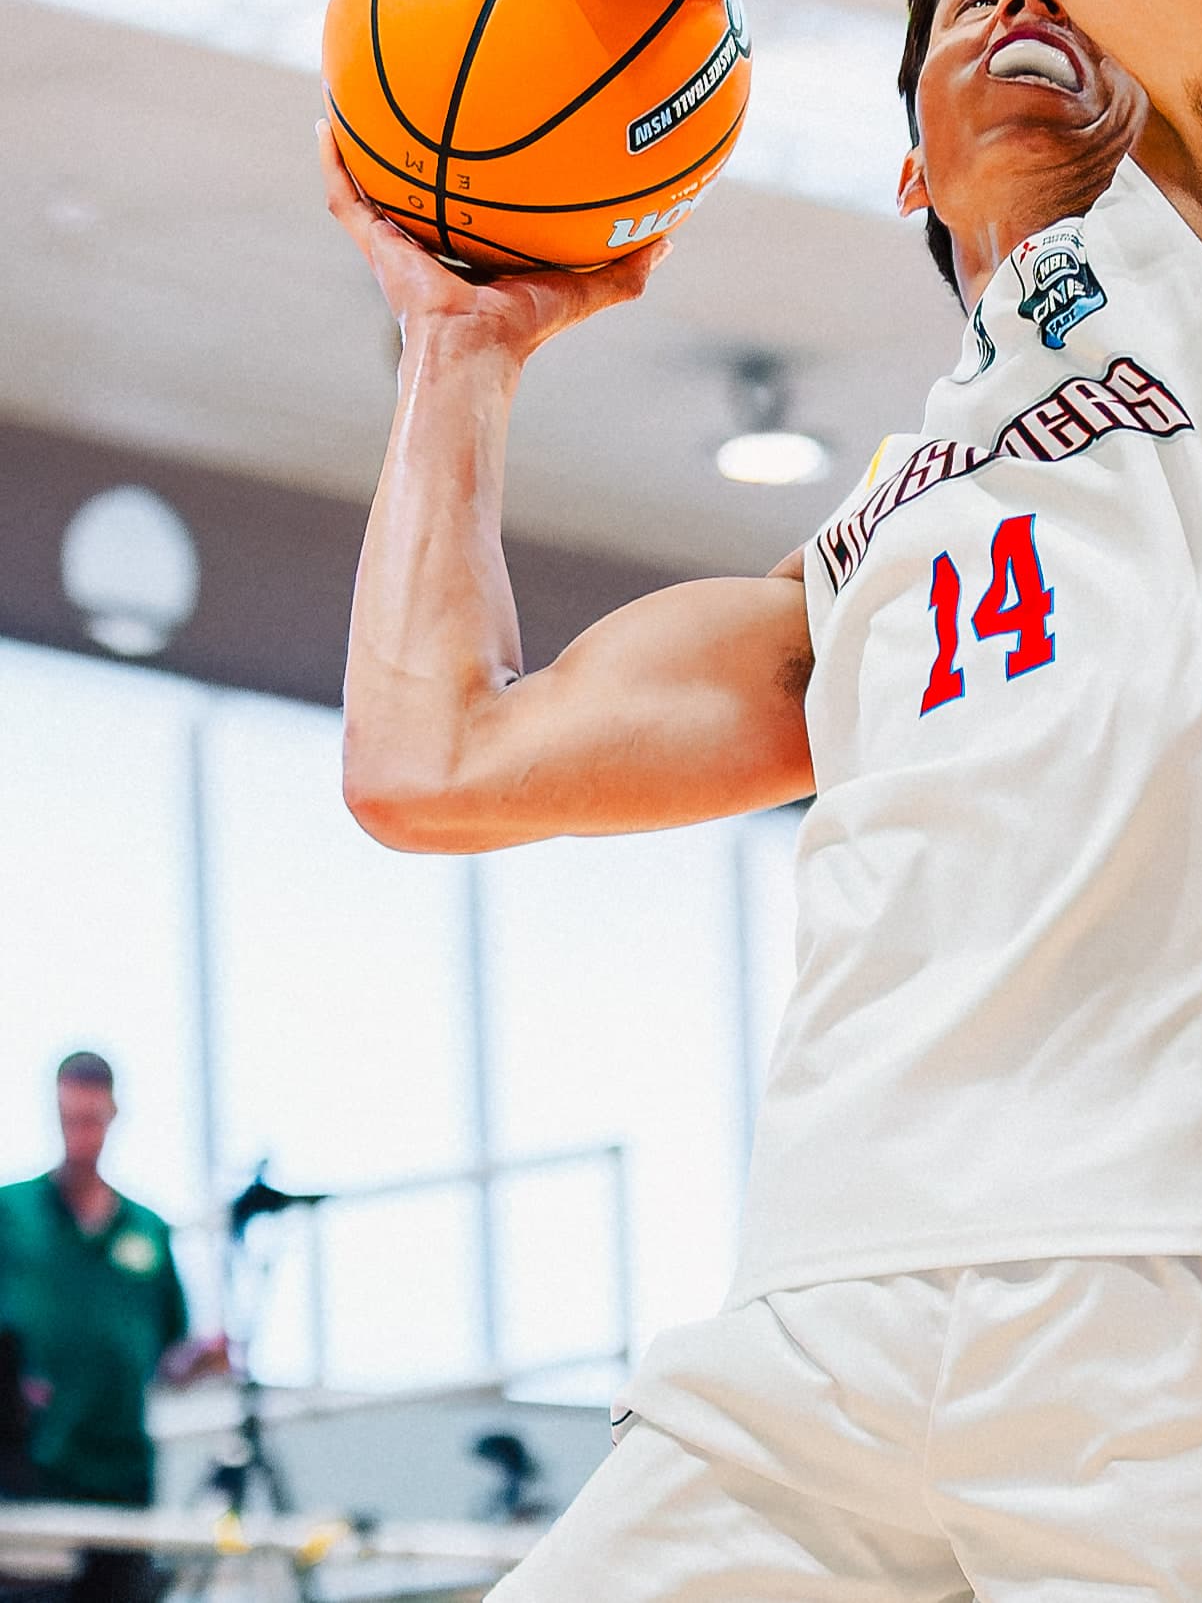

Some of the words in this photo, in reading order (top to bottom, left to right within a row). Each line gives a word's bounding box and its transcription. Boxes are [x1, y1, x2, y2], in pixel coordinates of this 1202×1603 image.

[671, 34, 737, 118] BASKETBALL
[635, 107, 673, 146] NSW
[1037, 253, 1071, 282] NBL
[1033, 278, 1086, 323] ONE
[1048, 309, 1077, 334] EAST
[815, 356, 1195, 597] CRUSERS
[919, 513, 1056, 719] 14
